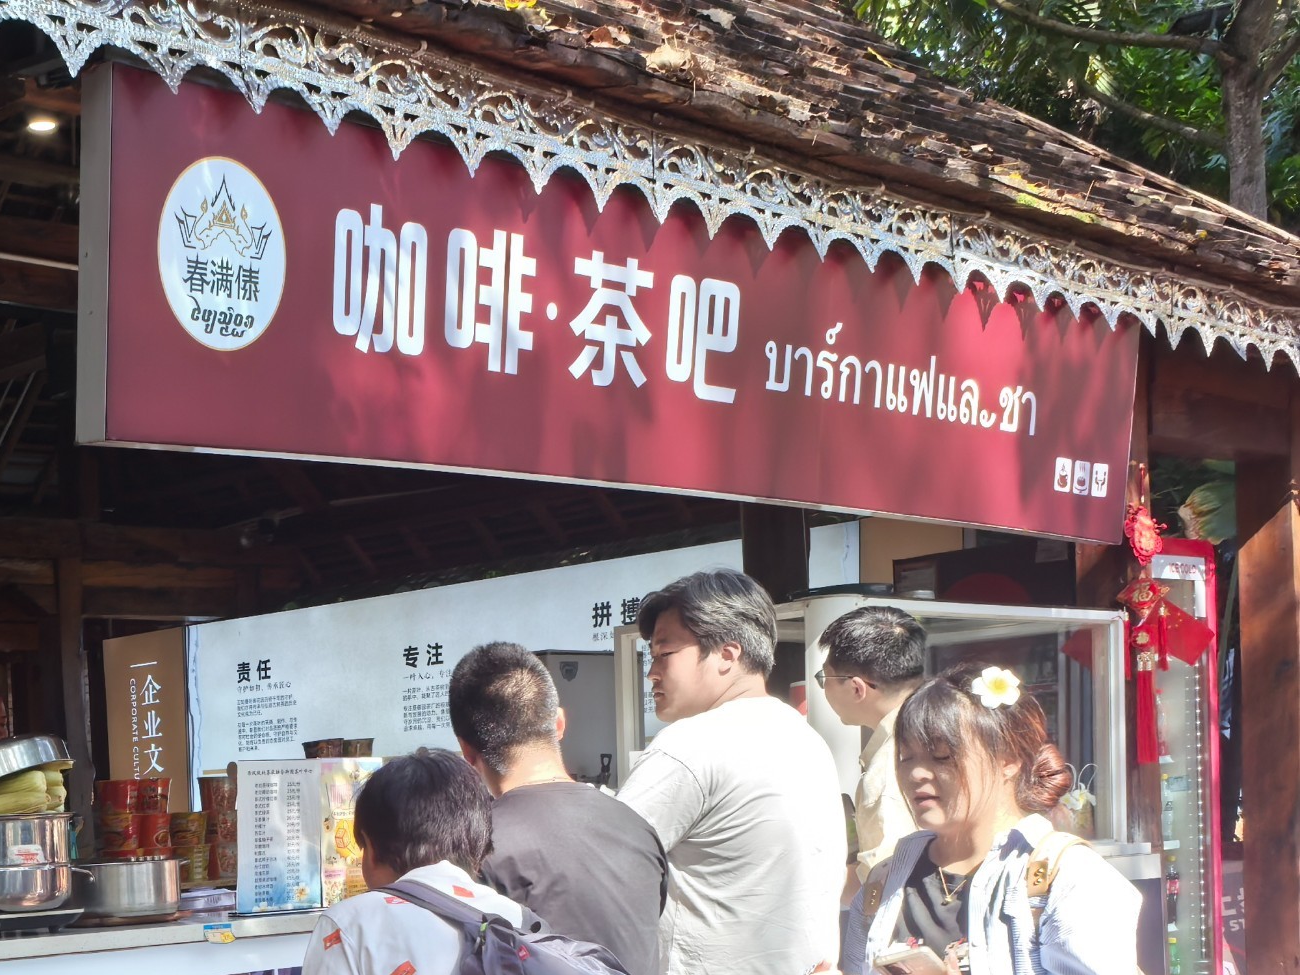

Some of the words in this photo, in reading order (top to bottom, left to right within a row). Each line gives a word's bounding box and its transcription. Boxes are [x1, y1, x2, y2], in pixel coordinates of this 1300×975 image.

[182, 252, 261, 302] 春满傣
[764, 322, 1038, 436] บาร์กาแฟและชา
[237, 659, 272, 684] 责任
[403, 643, 444, 668] 专注
[130, 678, 139, 742] CORPORATE
[140, 674, 164, 779] 企业文
